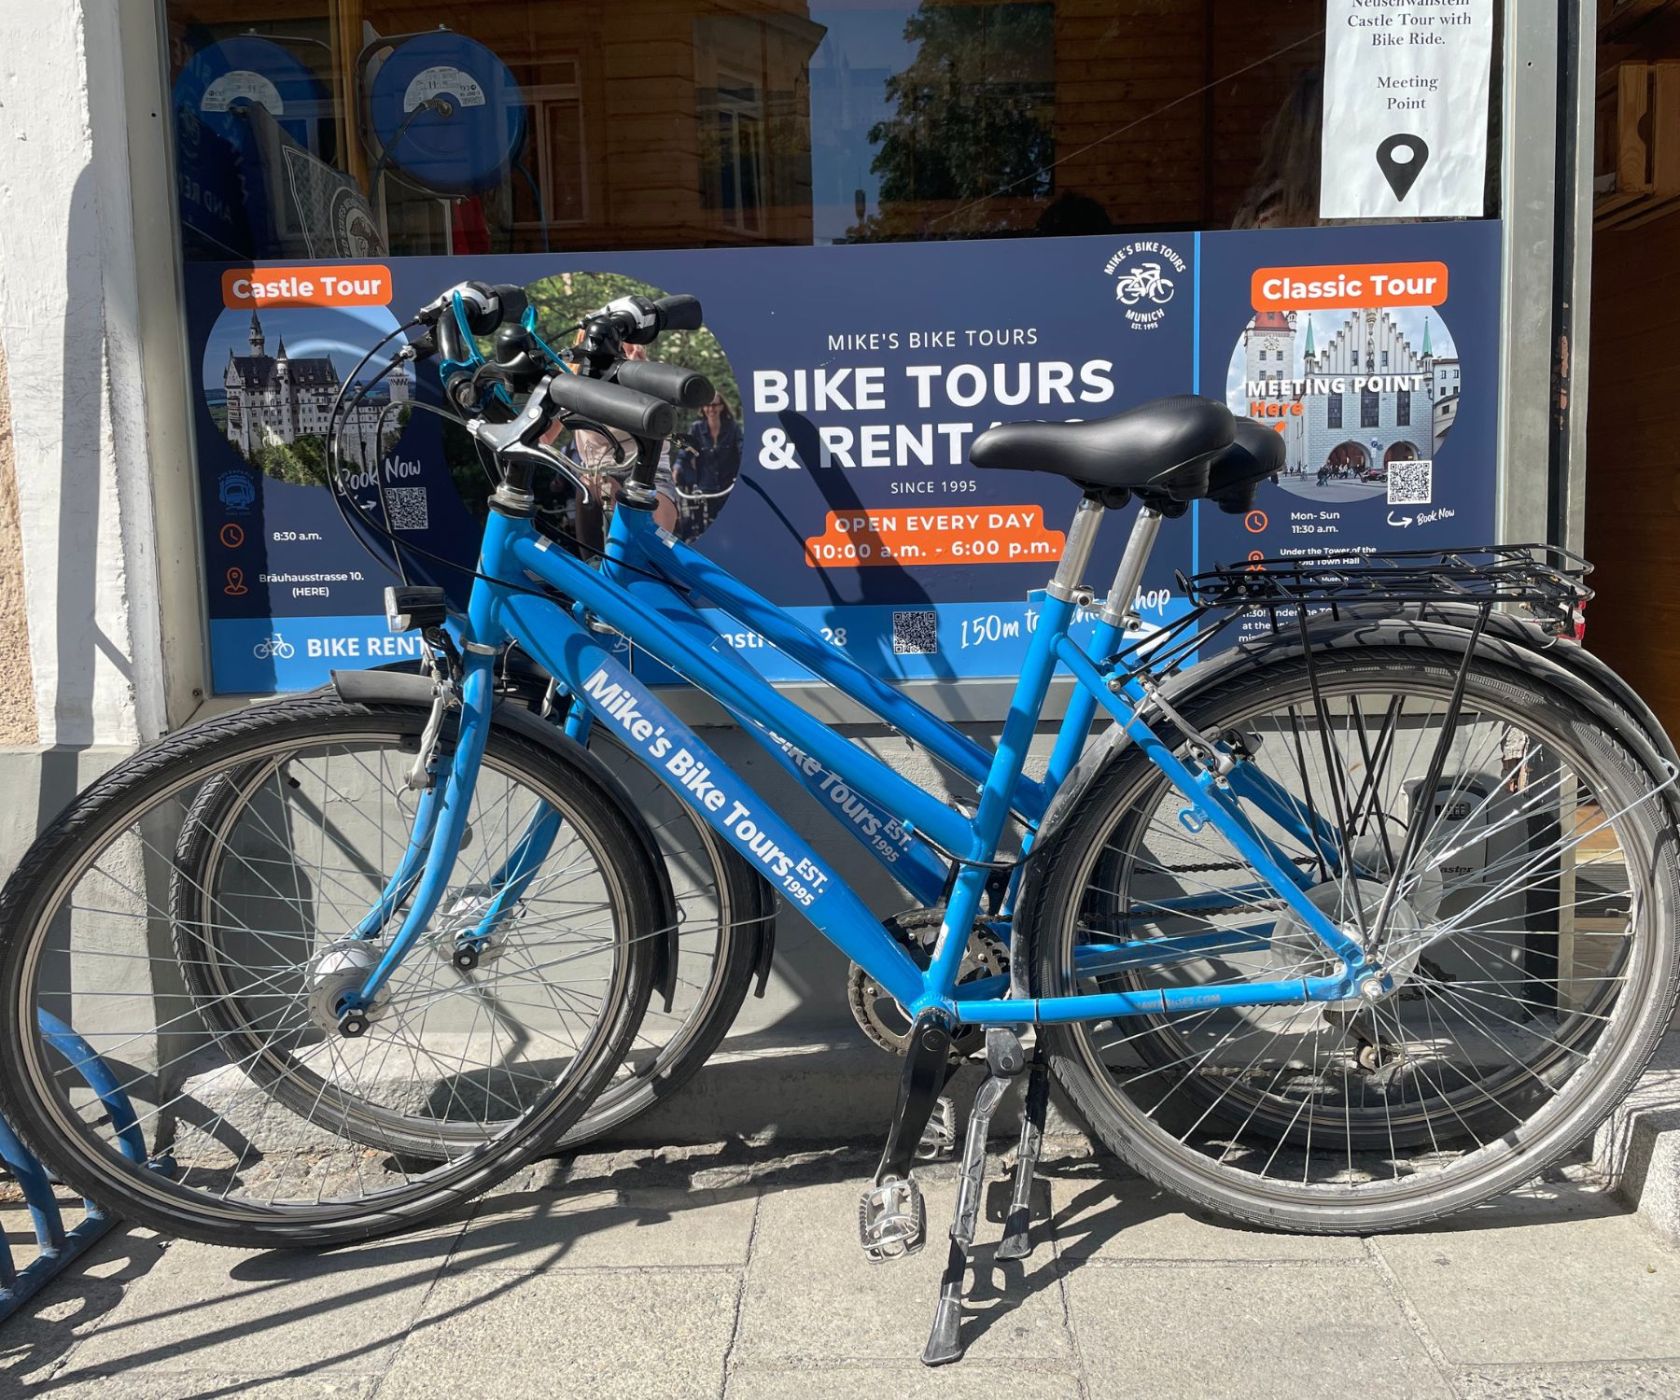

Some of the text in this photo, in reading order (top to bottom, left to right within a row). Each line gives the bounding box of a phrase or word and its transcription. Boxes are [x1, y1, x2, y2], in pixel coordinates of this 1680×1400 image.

[1347, 12, 1472, 27] Castle Tour with
[1372, 32, 1446, 46] Bike Ride.
[1377, 75, 1439, 92] Meeting
[1386, 97, 1426, 110] Point
[1104, 241, 1186, 275] MIKE'S BIKE TOURS
[231, 275, 382, 301] Castle Tour
[1262, 274, 1437, 300] Classic Tour
[1125, 308, 1165, 322] MUNICH
[1144, 322, 1158, 330] 1995
[828, 328, 1038, 351] MIKE'S BIKE TOURS
[753, 359, 1115, 412] BIKE TOURS
[1247, 375, 1424, 398] MEETING POINT
[1250, 401, 1304, 417] Here
[758, 419, 1084, 470] & RENT
[385, 455, 421, 483] Now
[890, 480, 977, 495] SINCE 1995
[834, 512, 1035, 533] OPEN EVERY DAY
[1290, 511, 1340, 520] Mon- Sun
[1416, 507, 1455, 526] Book Now
[273, 532, 322, 541] 8:30 a.m.
[1292, 525, 1339, 534] 11:30 a.m.
[813, 543, 871, 559] 10:00
[880, 544, 927, 558] a.m.
[951, 540, 1000, 556] 6:00
[1008, 540, 1057, 558] p.m.
[1280, 547, 1306, 556] Under
[1307, 547, 1322, 555] the
[1317, 558, 1340, 566] Town
[1343, 557, 1360, 565] Hall
[259, 570, 365, 583] Bräuhausstrasse 10.
[292, 587, 330, 598] (HERE)
[961, 615, 1019, 649] 150m
[1130, 585, 1170, 616] hop
[1242, 622, 1253, 630] at
[1254, 621, 1270, 630] the
[307, 638, 360, 657] BIKE
[583, 669, 795, 878] Mike's Bike Tours
[819, 770, 882, 836] Tours
[883, 819, 912, 851] EST.
[872, 834, 900, 863] 1995
[795, 856, 828, 894] EST.
[782, 875, 815, 907] 1995
